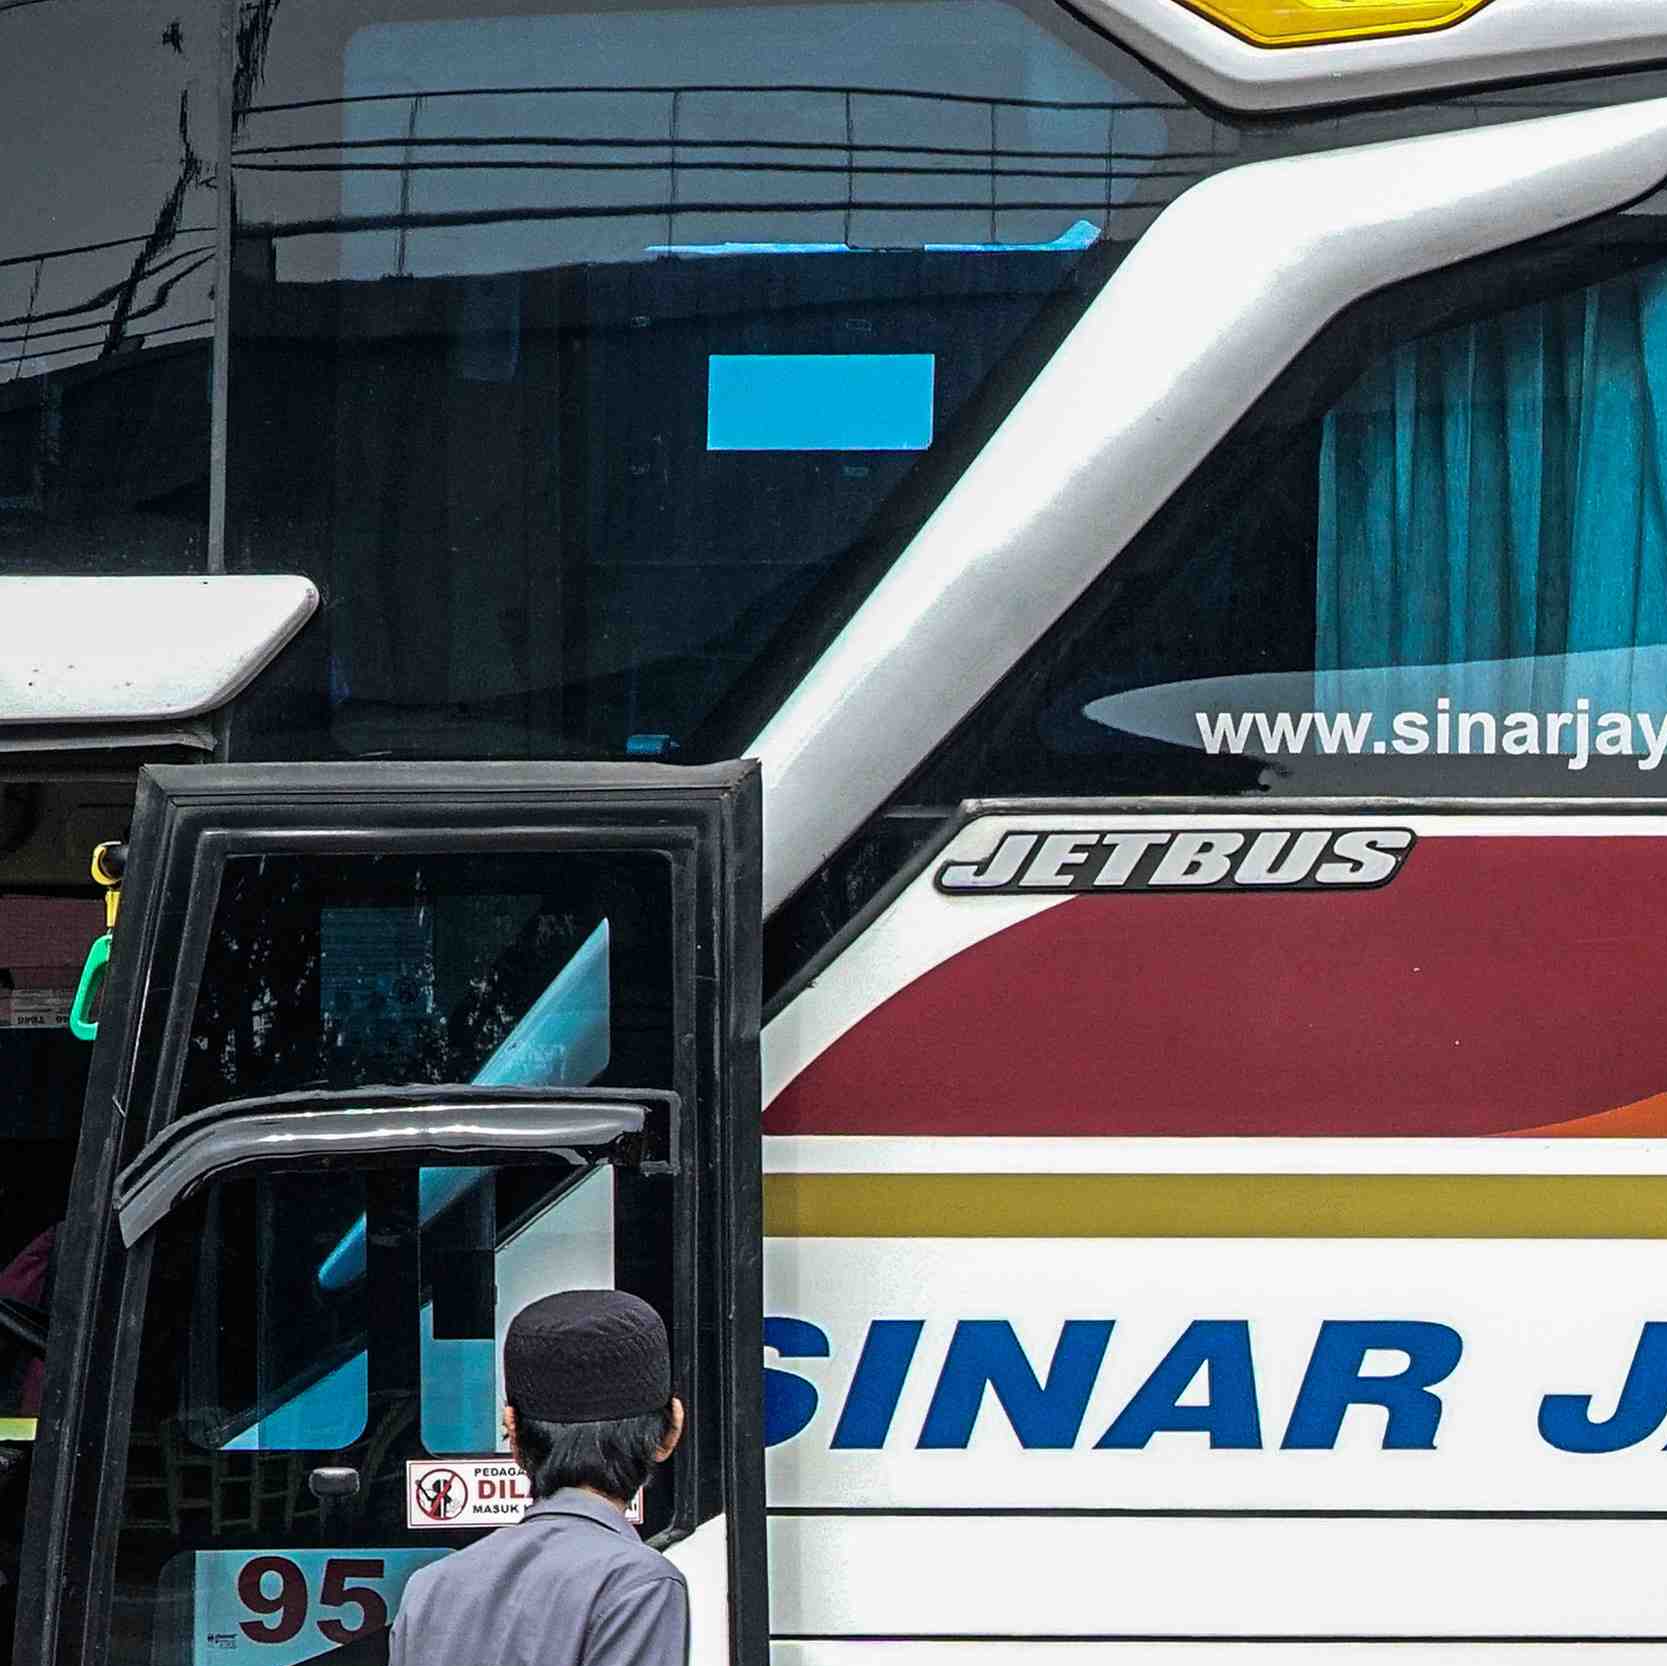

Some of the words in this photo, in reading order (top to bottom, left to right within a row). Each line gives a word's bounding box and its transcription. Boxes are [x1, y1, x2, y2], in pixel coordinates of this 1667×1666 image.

[944, 830, 1414, 888] JETBUS
[763, 1317, 1465, 1452] SINAR
[472, 1503, 520, 1515] MASUK
[478, 1479, 534, 1500] DIL
[238, 1555, 388, 1645] 95
